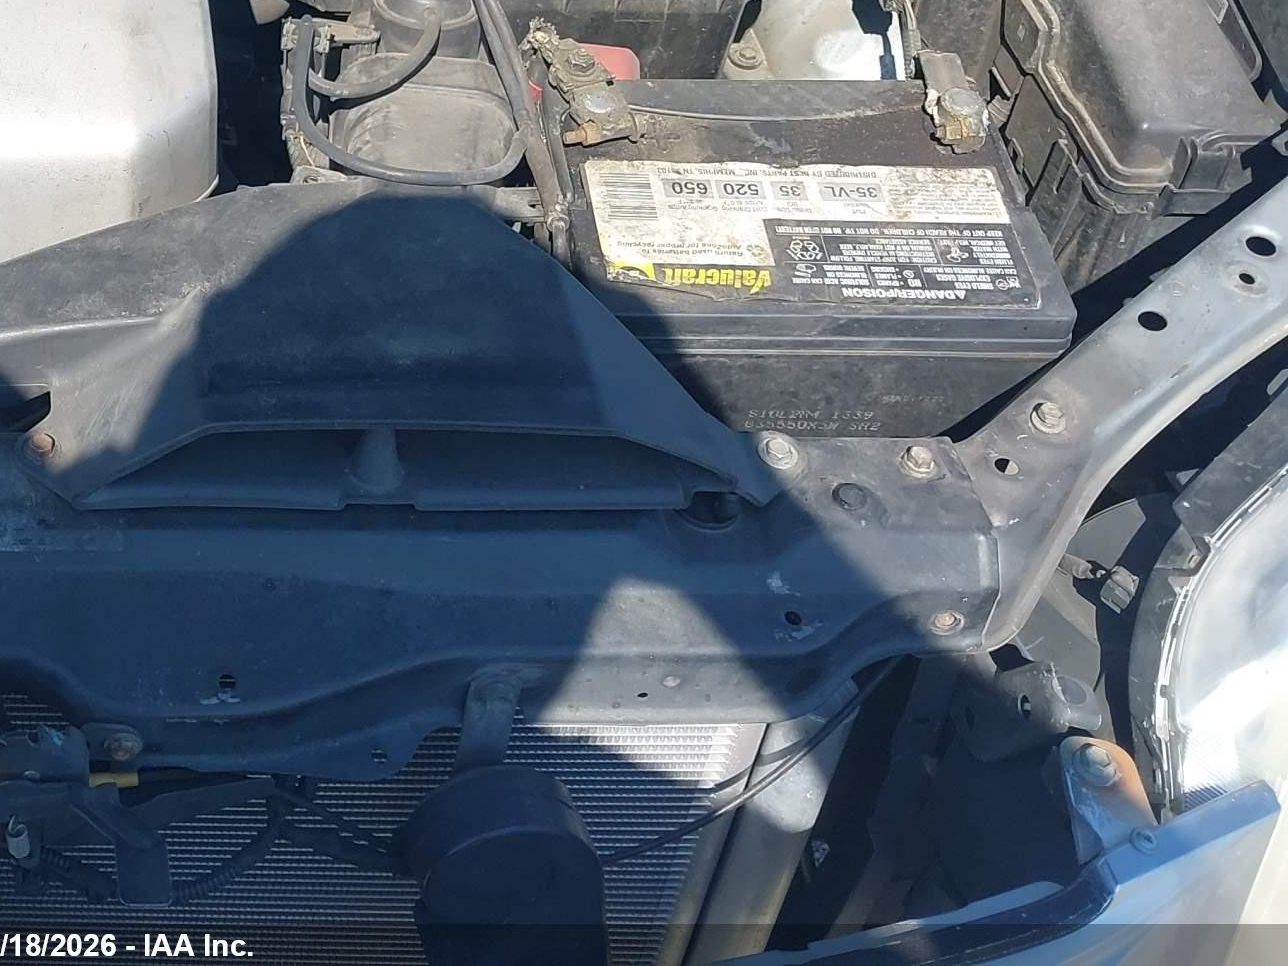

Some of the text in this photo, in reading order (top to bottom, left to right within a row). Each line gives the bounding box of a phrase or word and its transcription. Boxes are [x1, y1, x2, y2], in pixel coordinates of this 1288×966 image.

[671, 182, 708, 195] 650
[723, 183, 759, 195] 520
[779, 186, 800, 197] 35
[823, 186, 878, 198] 35-VL
[662, 268, 771, 294] Valucraft
[908, 279, 922, 287] NO
[841, 288, 955, 299] DANGER/POISON
